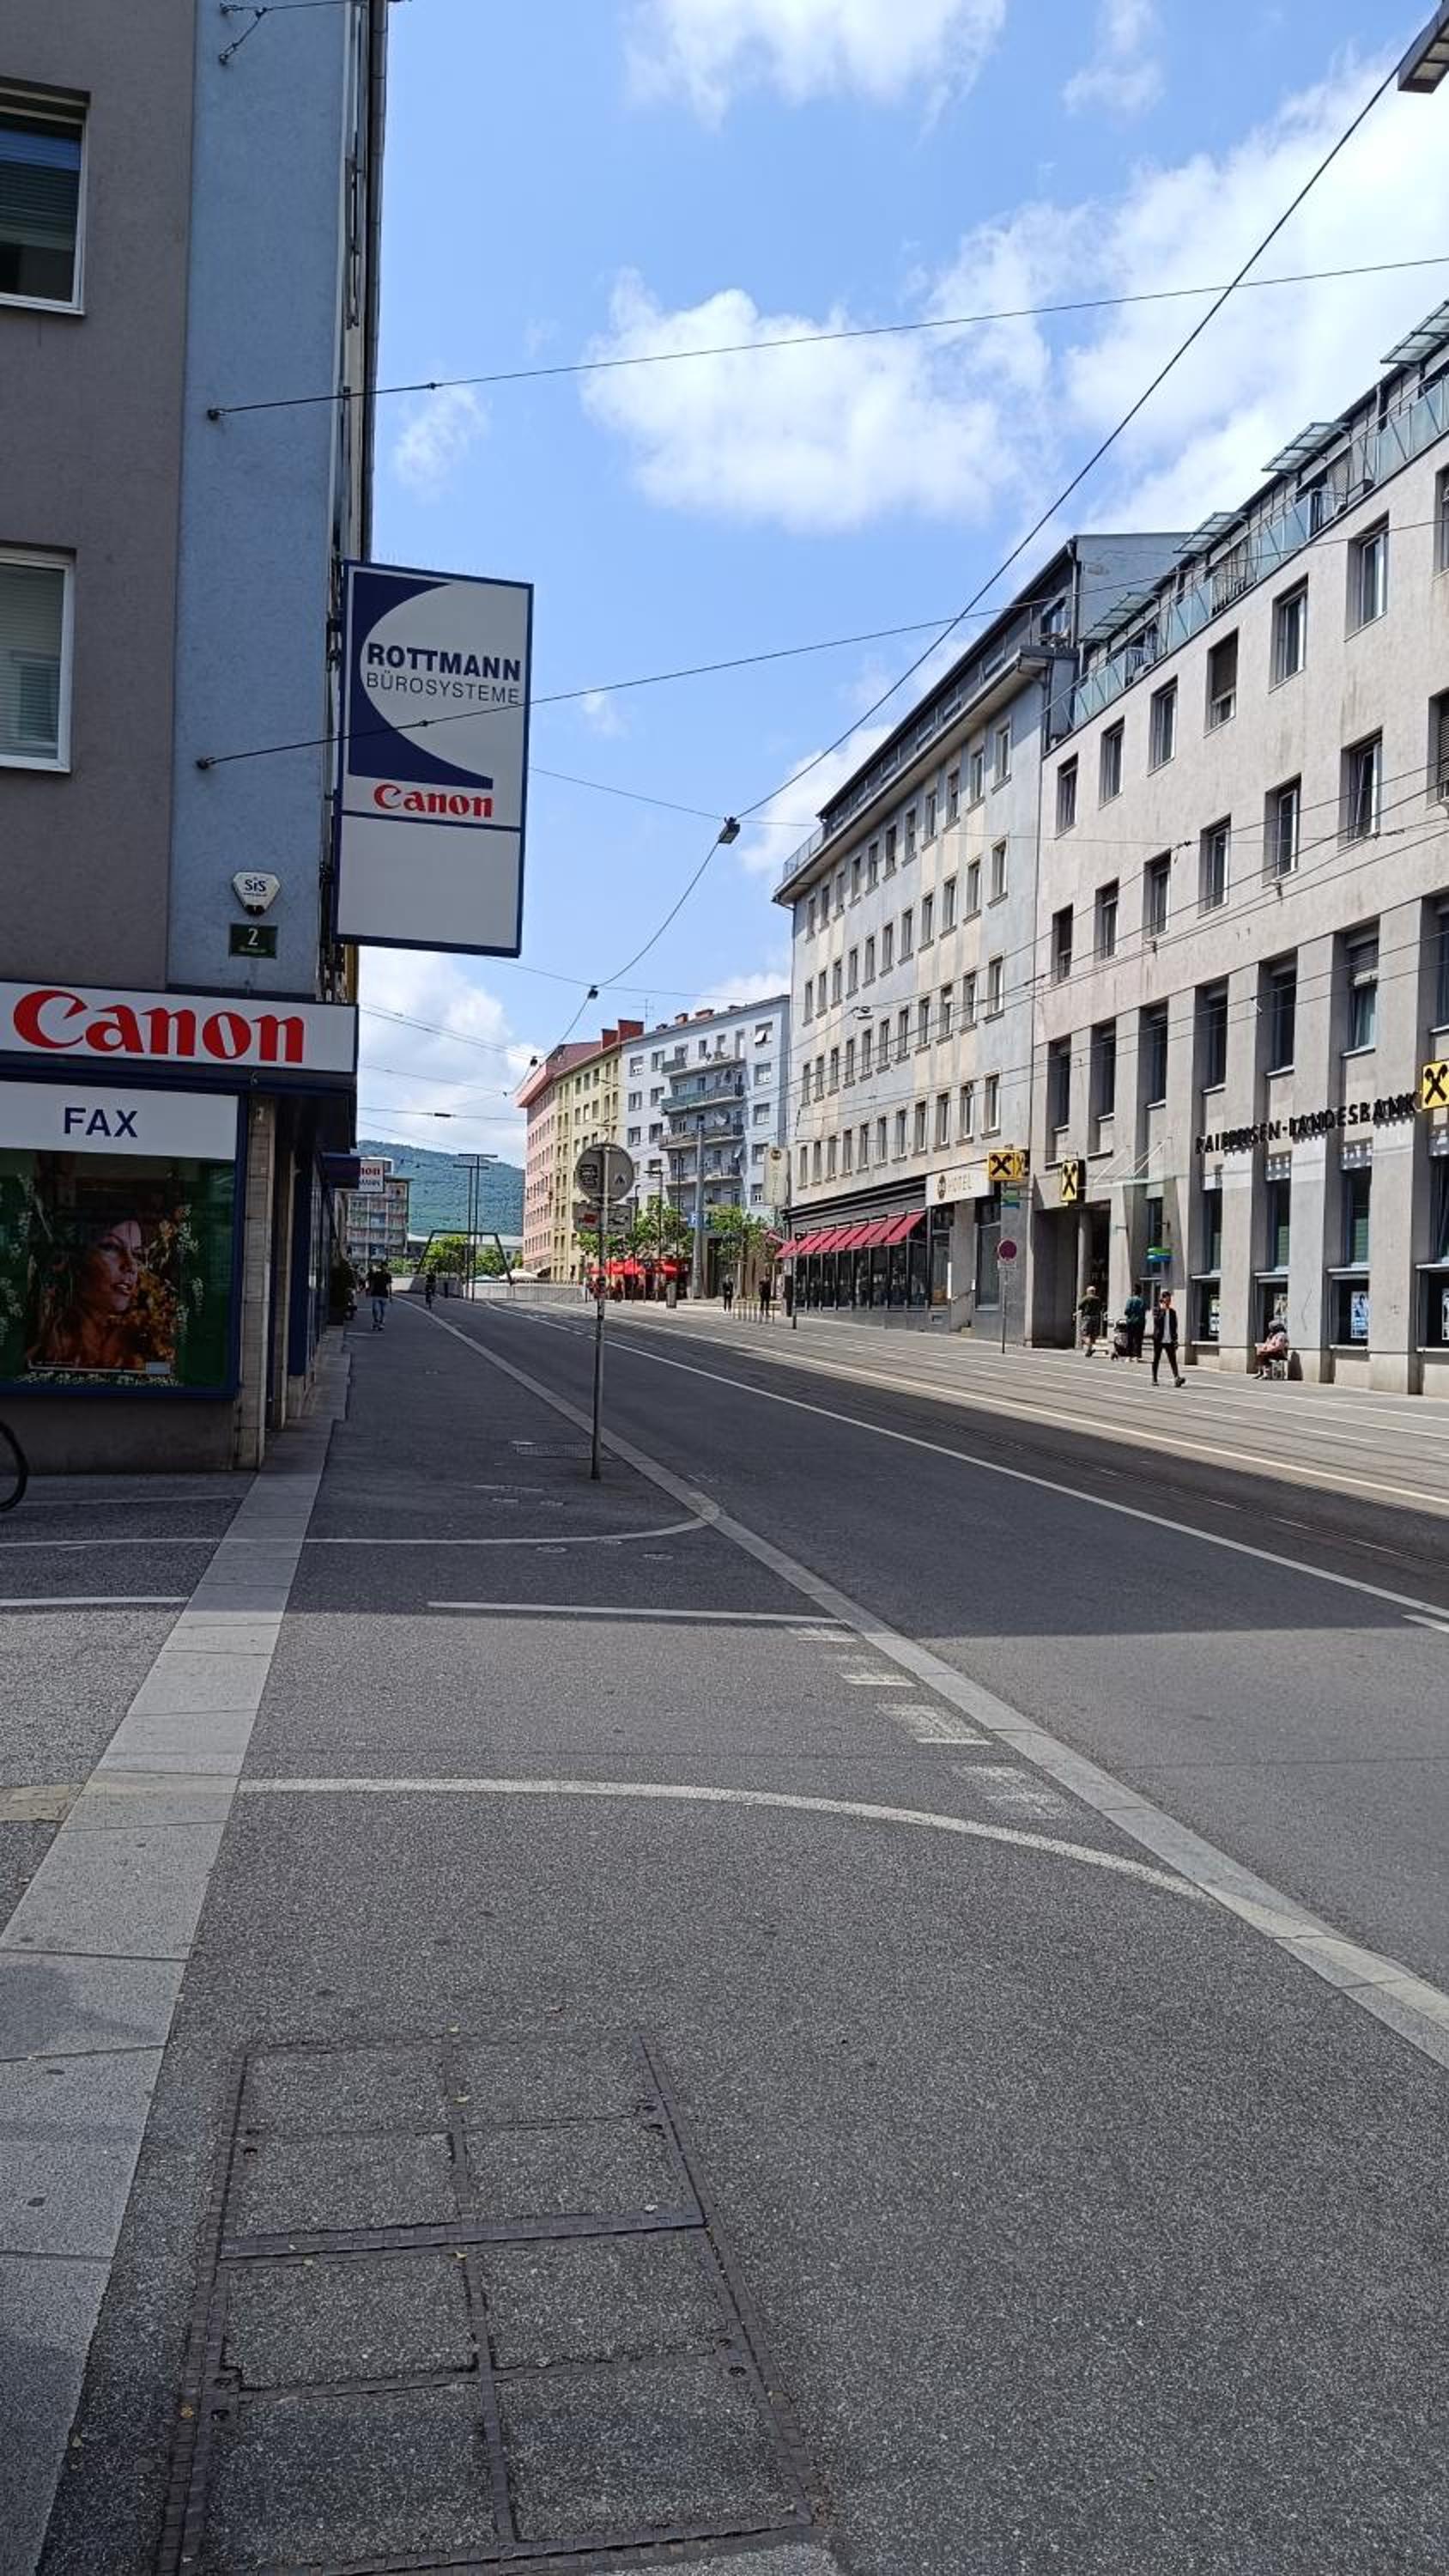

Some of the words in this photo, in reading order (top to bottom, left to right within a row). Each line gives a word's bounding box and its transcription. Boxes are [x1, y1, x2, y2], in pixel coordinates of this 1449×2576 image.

[367, 642, 521, 682] ROTTMANN
[367, 670, 520, 705] BÜROSYSTEME
[373, 783, 494, 818] Canon
[248, 927, 258, 946] 2
[13, 989, 306, 1064] Canon
[64, 1106, 138, 1139] FAX
